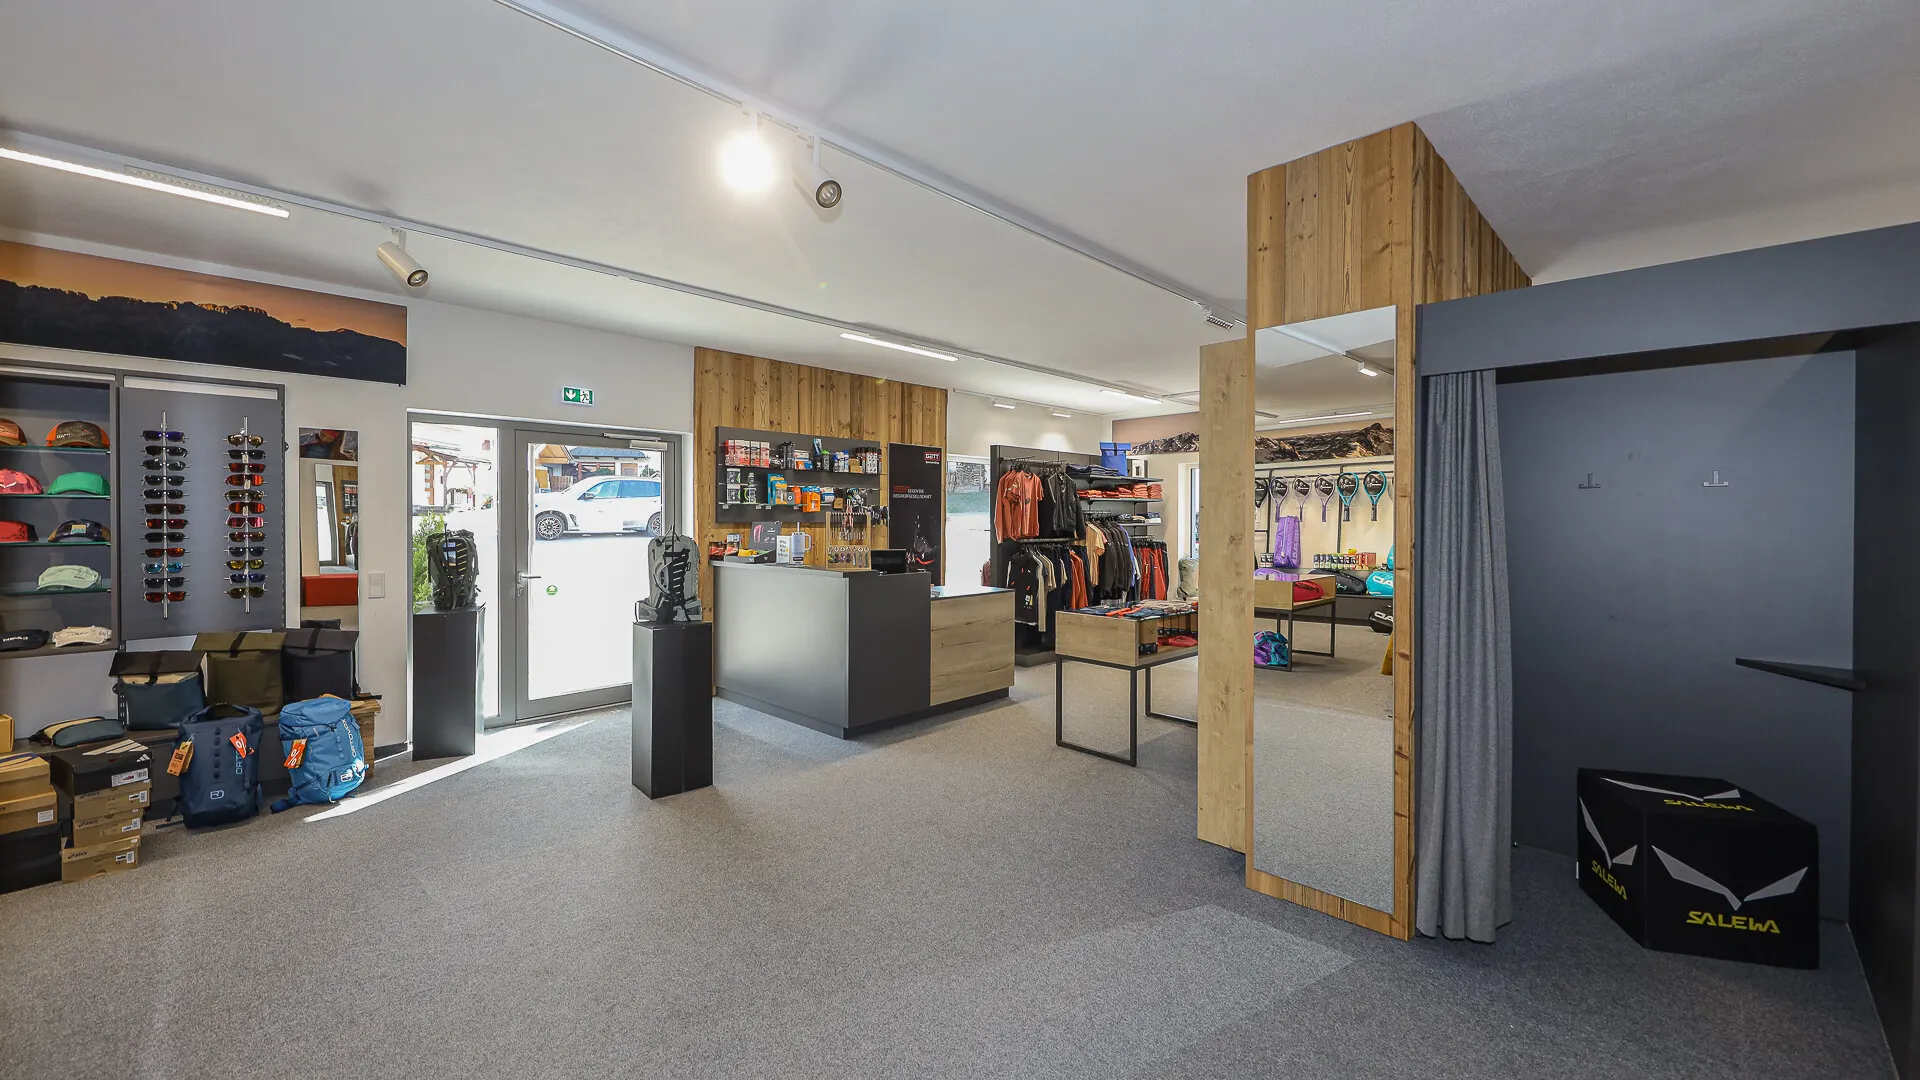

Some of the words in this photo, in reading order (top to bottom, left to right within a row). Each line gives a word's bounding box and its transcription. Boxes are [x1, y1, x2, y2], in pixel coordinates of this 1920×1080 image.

[340, 718, 357, 758] ORTOVOX
[1663, 799, 1756, 812] SALEWA
[1591, 860, 1628, 901] SALEWA
[1685, 911, 1781, 934] SALEWA
